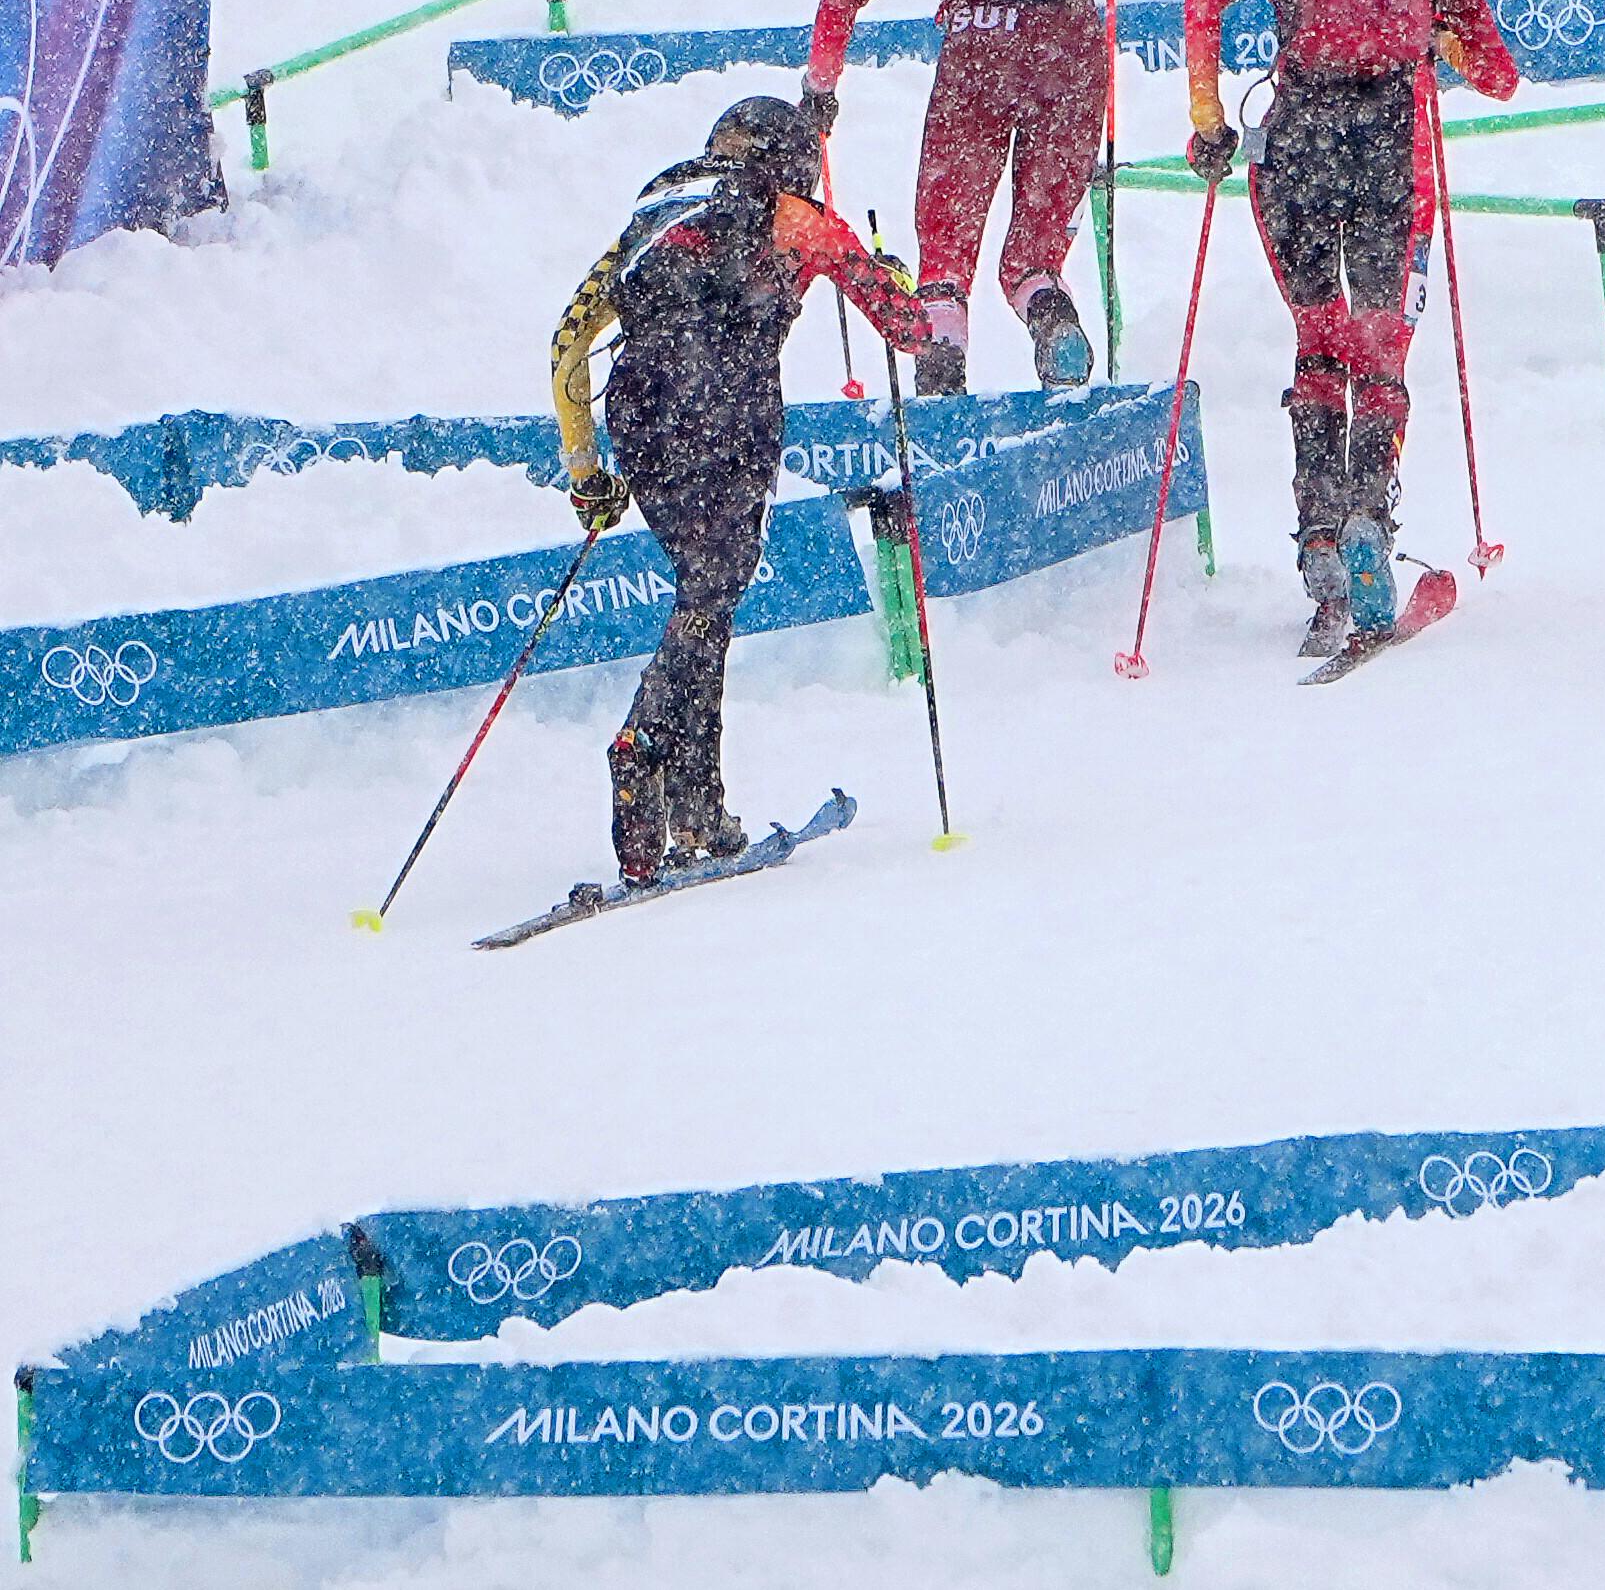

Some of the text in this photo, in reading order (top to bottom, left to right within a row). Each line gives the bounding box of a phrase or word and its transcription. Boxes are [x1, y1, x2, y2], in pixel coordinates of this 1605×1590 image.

[1235, 31, 1279, 65] 20
[1415, 283, 1426, 313] 3
[781, 437, 1001, 478] ORTINA 20
[1036, 437, 1190, 518] MILANO CORTINA 206
[327, 600, 500, 660] MILANO
[507, 570, 677, 628] CORTINA
[756, 1190, 1247, 1270] MILANO CORTINA 2026
[189, 1318, 249, 1369] MILANO
[247, 1290, 321, 1350] CORTINA
[485, 1399, 1045, 1445] MILANO CORTINA 2026
